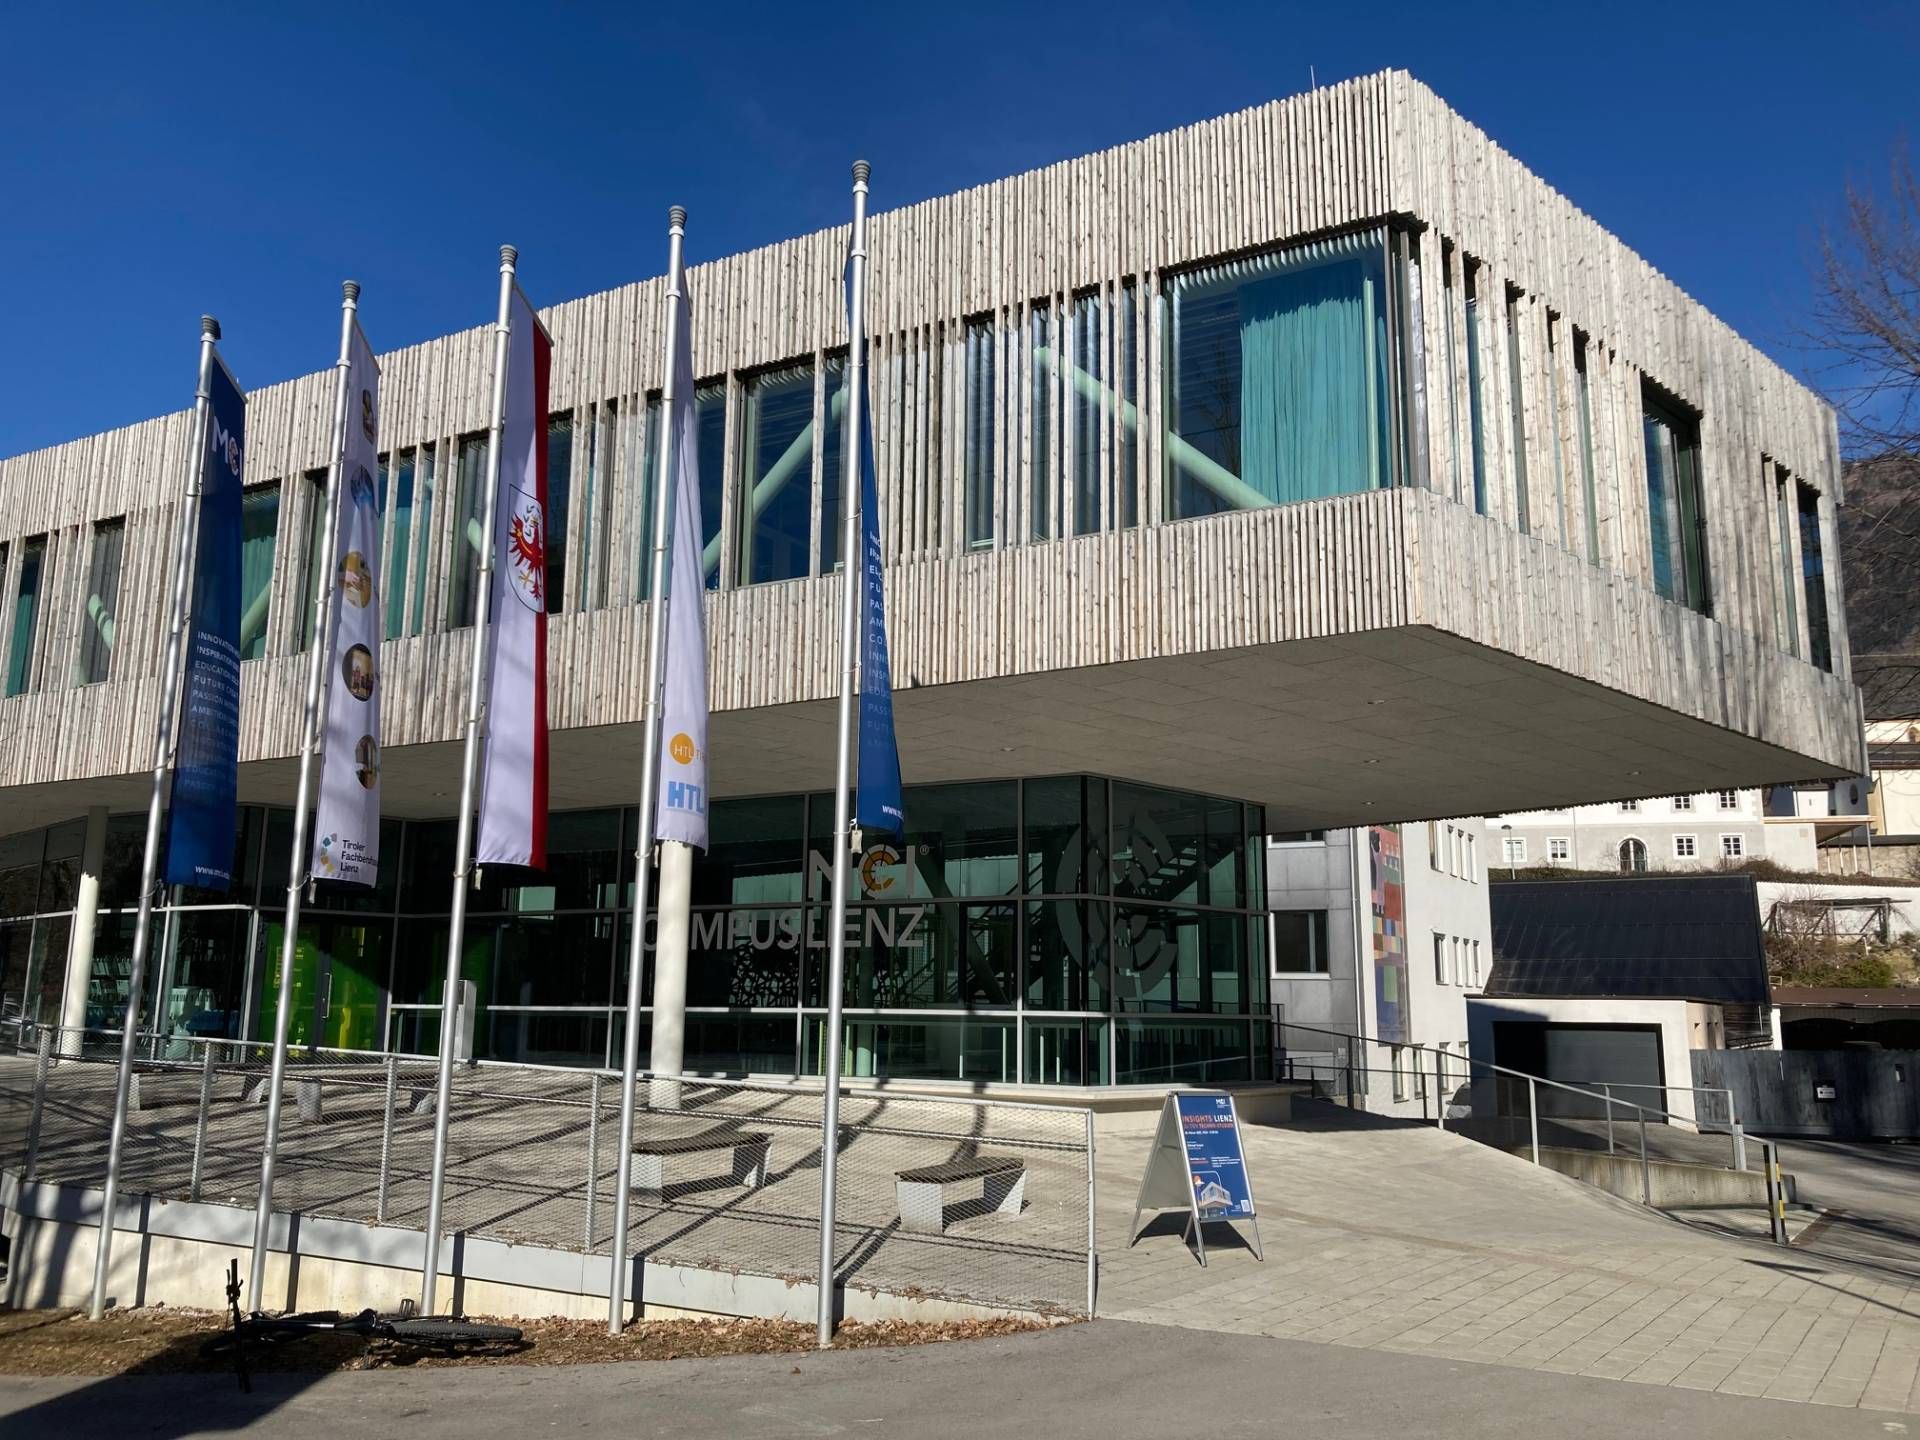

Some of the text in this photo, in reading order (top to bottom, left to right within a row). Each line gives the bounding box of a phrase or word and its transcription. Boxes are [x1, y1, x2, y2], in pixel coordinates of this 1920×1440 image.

[667, 781, 705, 814] HTL
[342, 839, 366, 851] Tiroler
[340, 861, 359, 873] Lienz
[642, 908, 800, 951] MPUS
[1213, 1114, 1233, 1122] LIENZ
